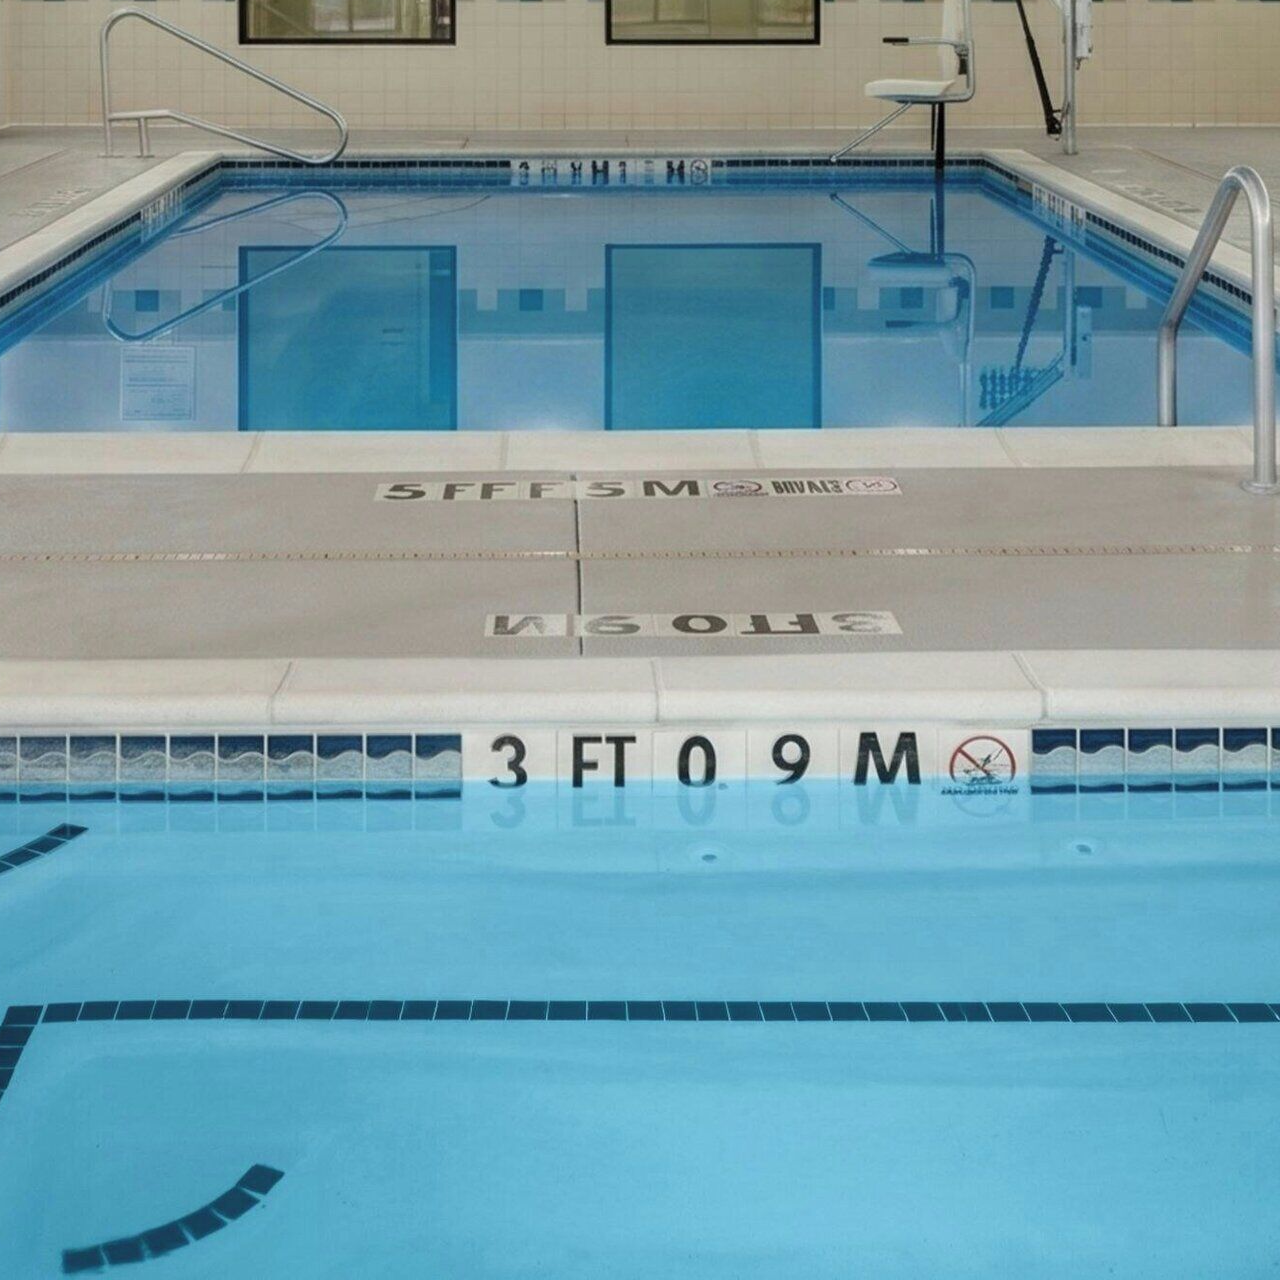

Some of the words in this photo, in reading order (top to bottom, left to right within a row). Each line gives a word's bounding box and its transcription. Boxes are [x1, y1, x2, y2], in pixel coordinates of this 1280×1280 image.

[642, 480, 701, 497] M
[487, 734, 528, 788] 3
[571, 735, 637, 788] FT
[771, 734, 811, 786] 9
[853, 731, 922, 786] M
